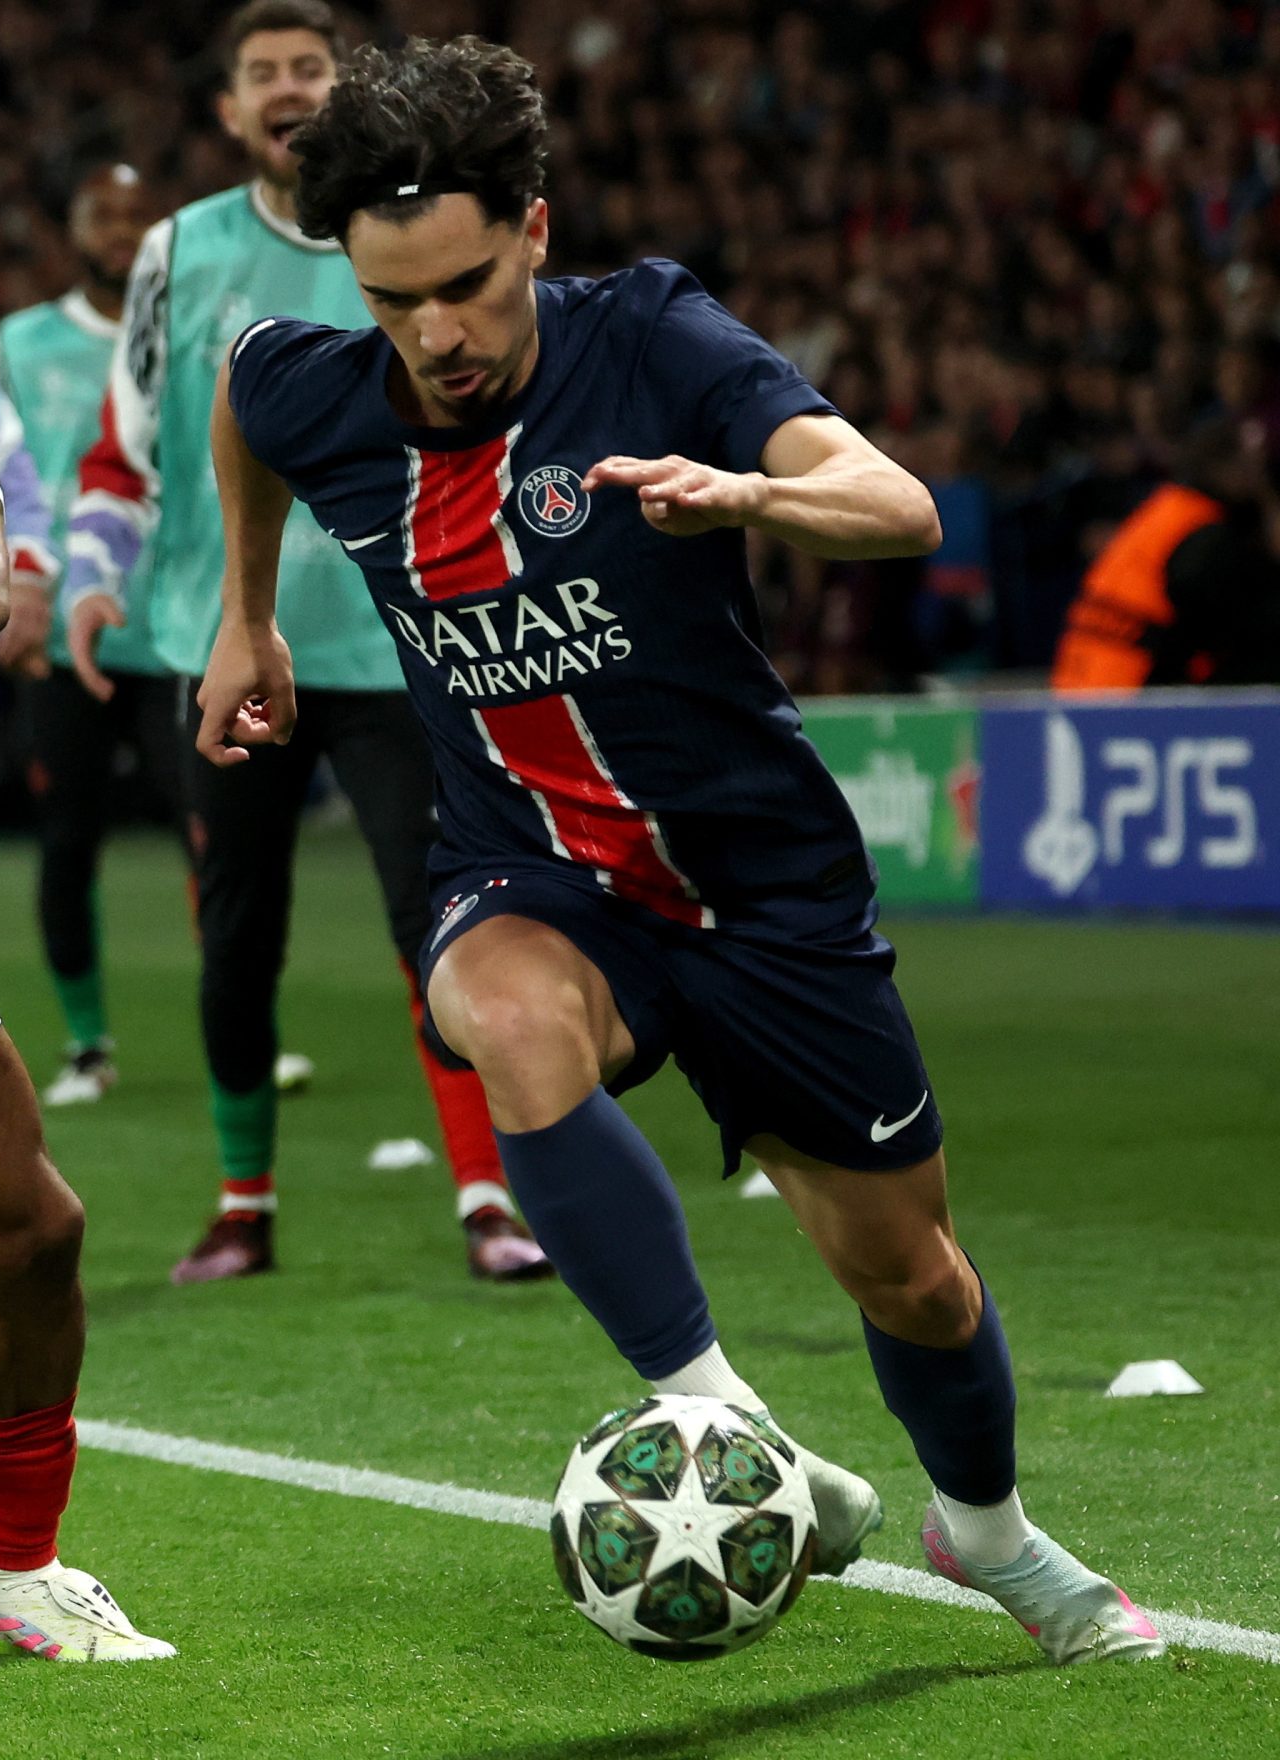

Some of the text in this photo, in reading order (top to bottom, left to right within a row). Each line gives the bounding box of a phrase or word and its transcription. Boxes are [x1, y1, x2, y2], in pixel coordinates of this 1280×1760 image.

[524, 469, 570, 492] PARIS
[385, 577, 619, 667] QATAR
[447, 625, 632, 696] AIRWAYS
[1100, 737, 1257, 868] PS5
